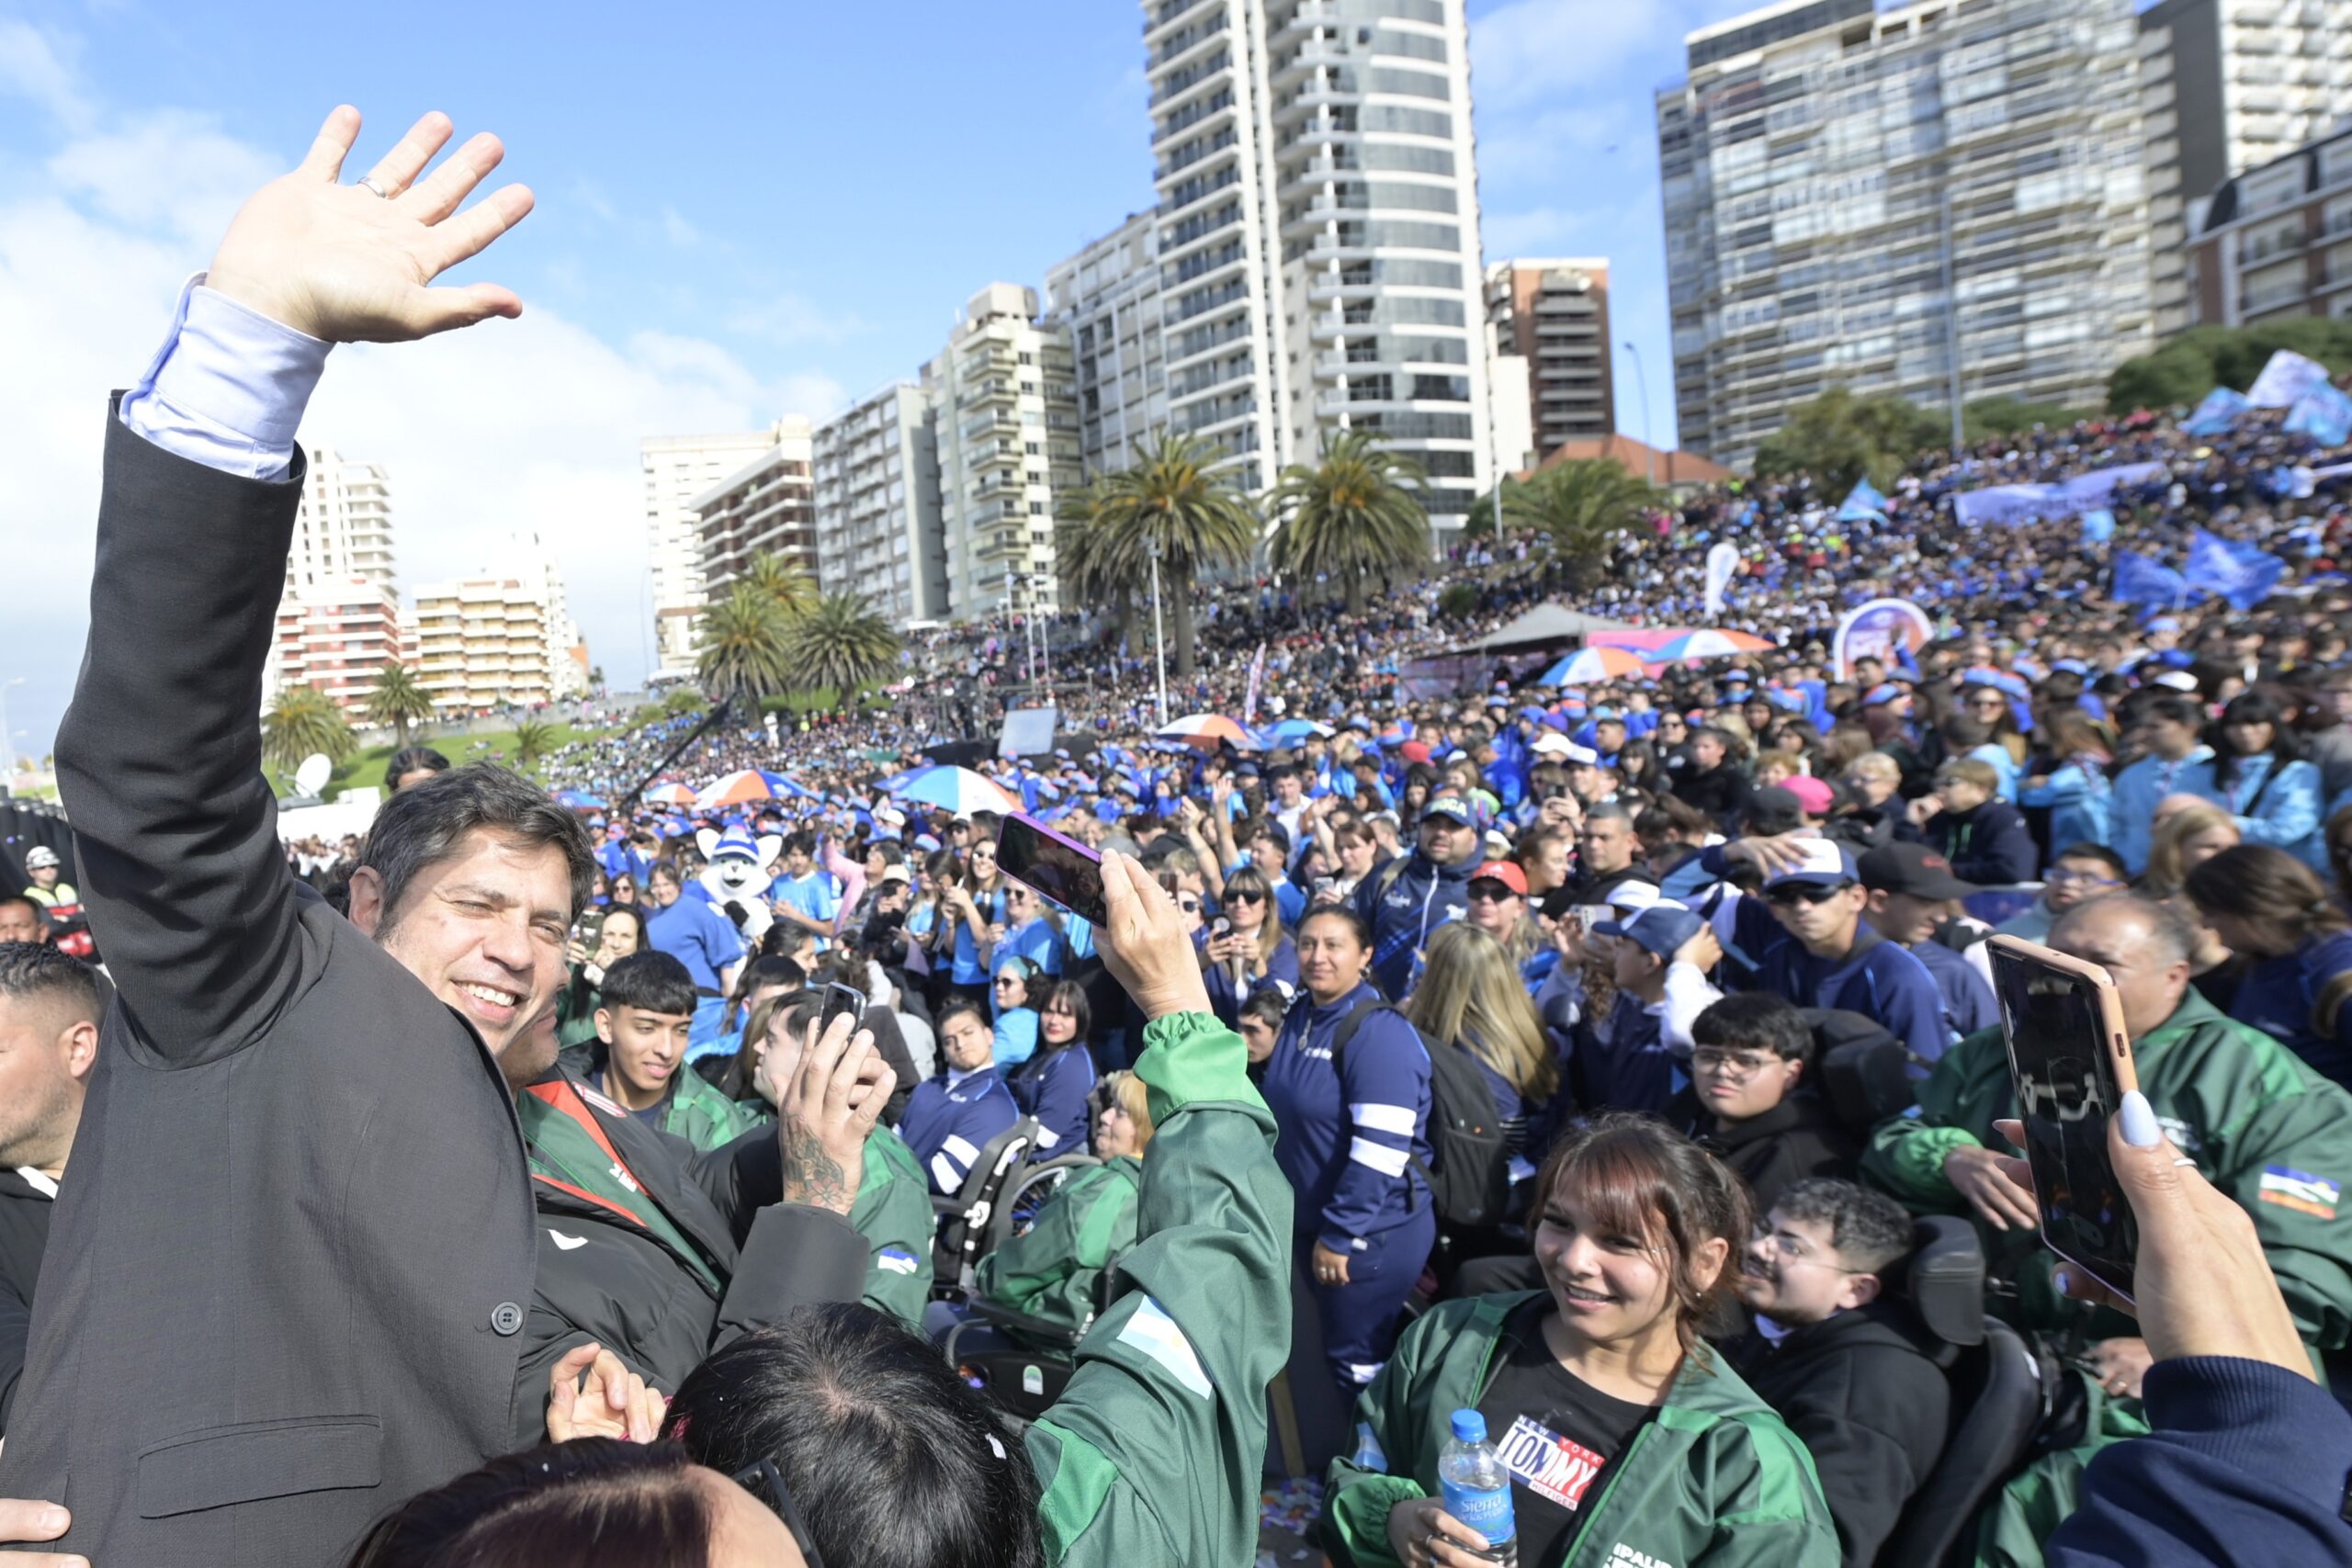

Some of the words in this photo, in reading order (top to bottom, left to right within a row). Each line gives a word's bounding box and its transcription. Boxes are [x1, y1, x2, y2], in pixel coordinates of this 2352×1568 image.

[1518, 1415, 1550, 1436] NEW
[1561, 1438, 1601, 1464] YORK
[1461, 1495, 1502, 1514] Sierra
[1531, 1482, 1577, 1509] HILFIGER
